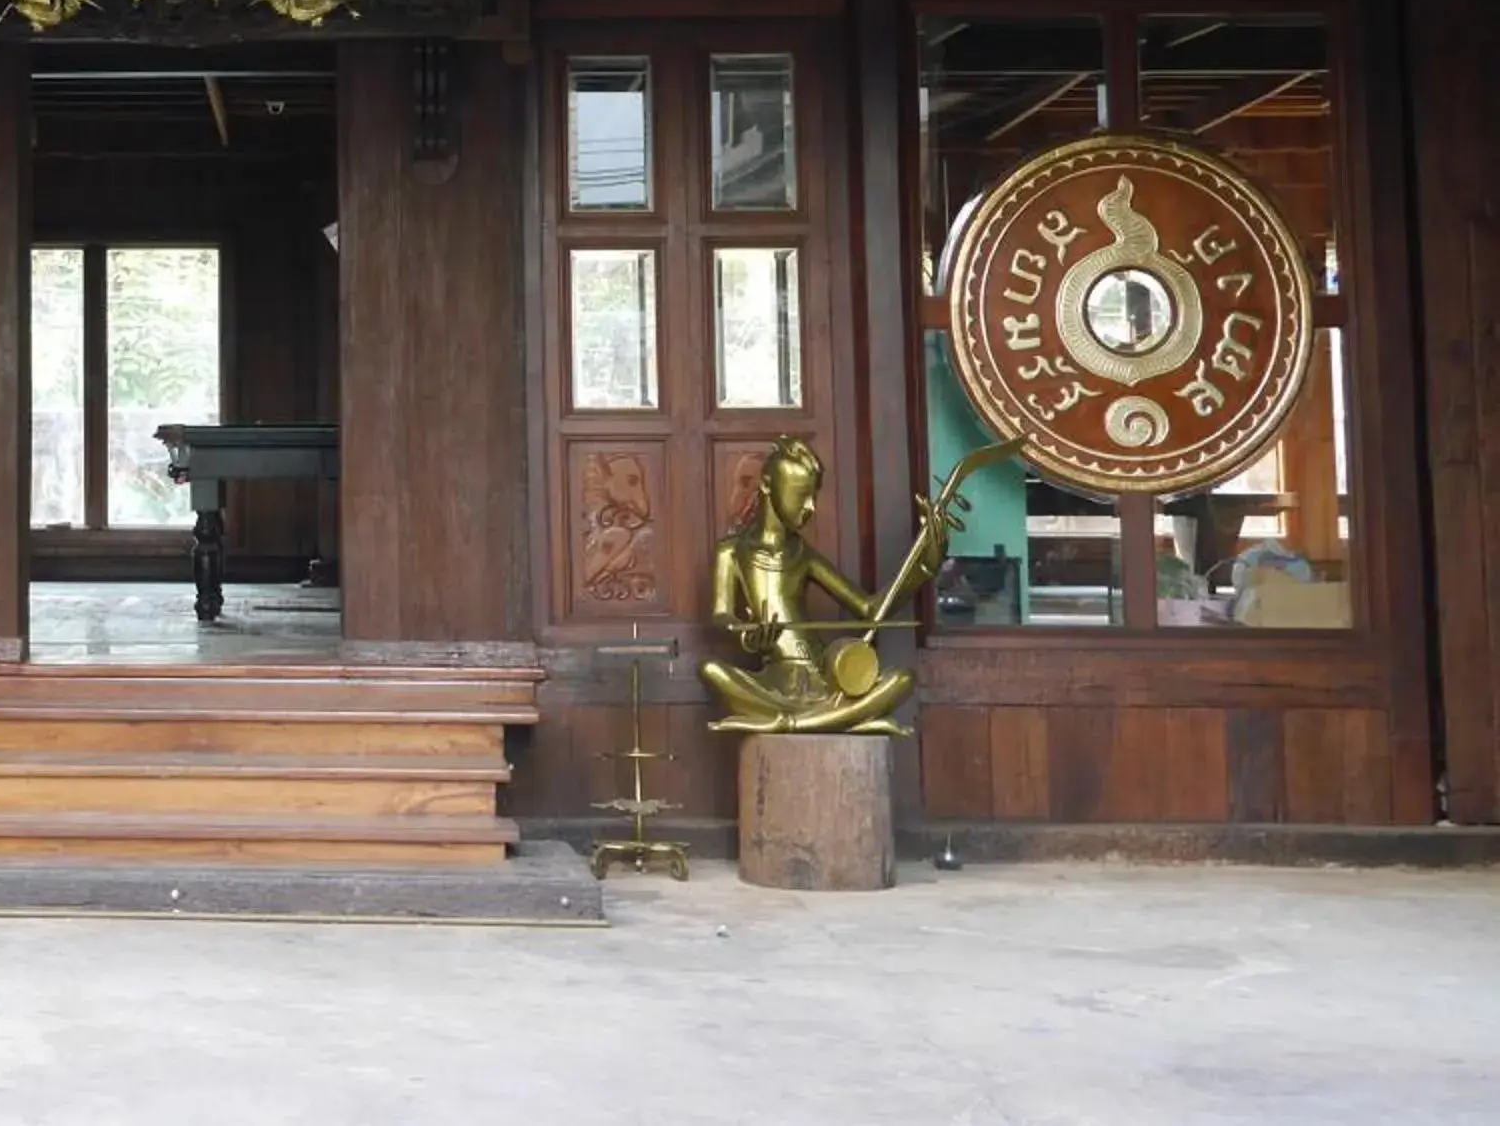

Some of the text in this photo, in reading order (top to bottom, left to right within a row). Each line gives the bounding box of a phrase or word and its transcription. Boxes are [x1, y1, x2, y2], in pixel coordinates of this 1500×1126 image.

[1003, 209, 1103, 421] สยามรัฐ
[1168, 224, 1261, 417] สตางค์
